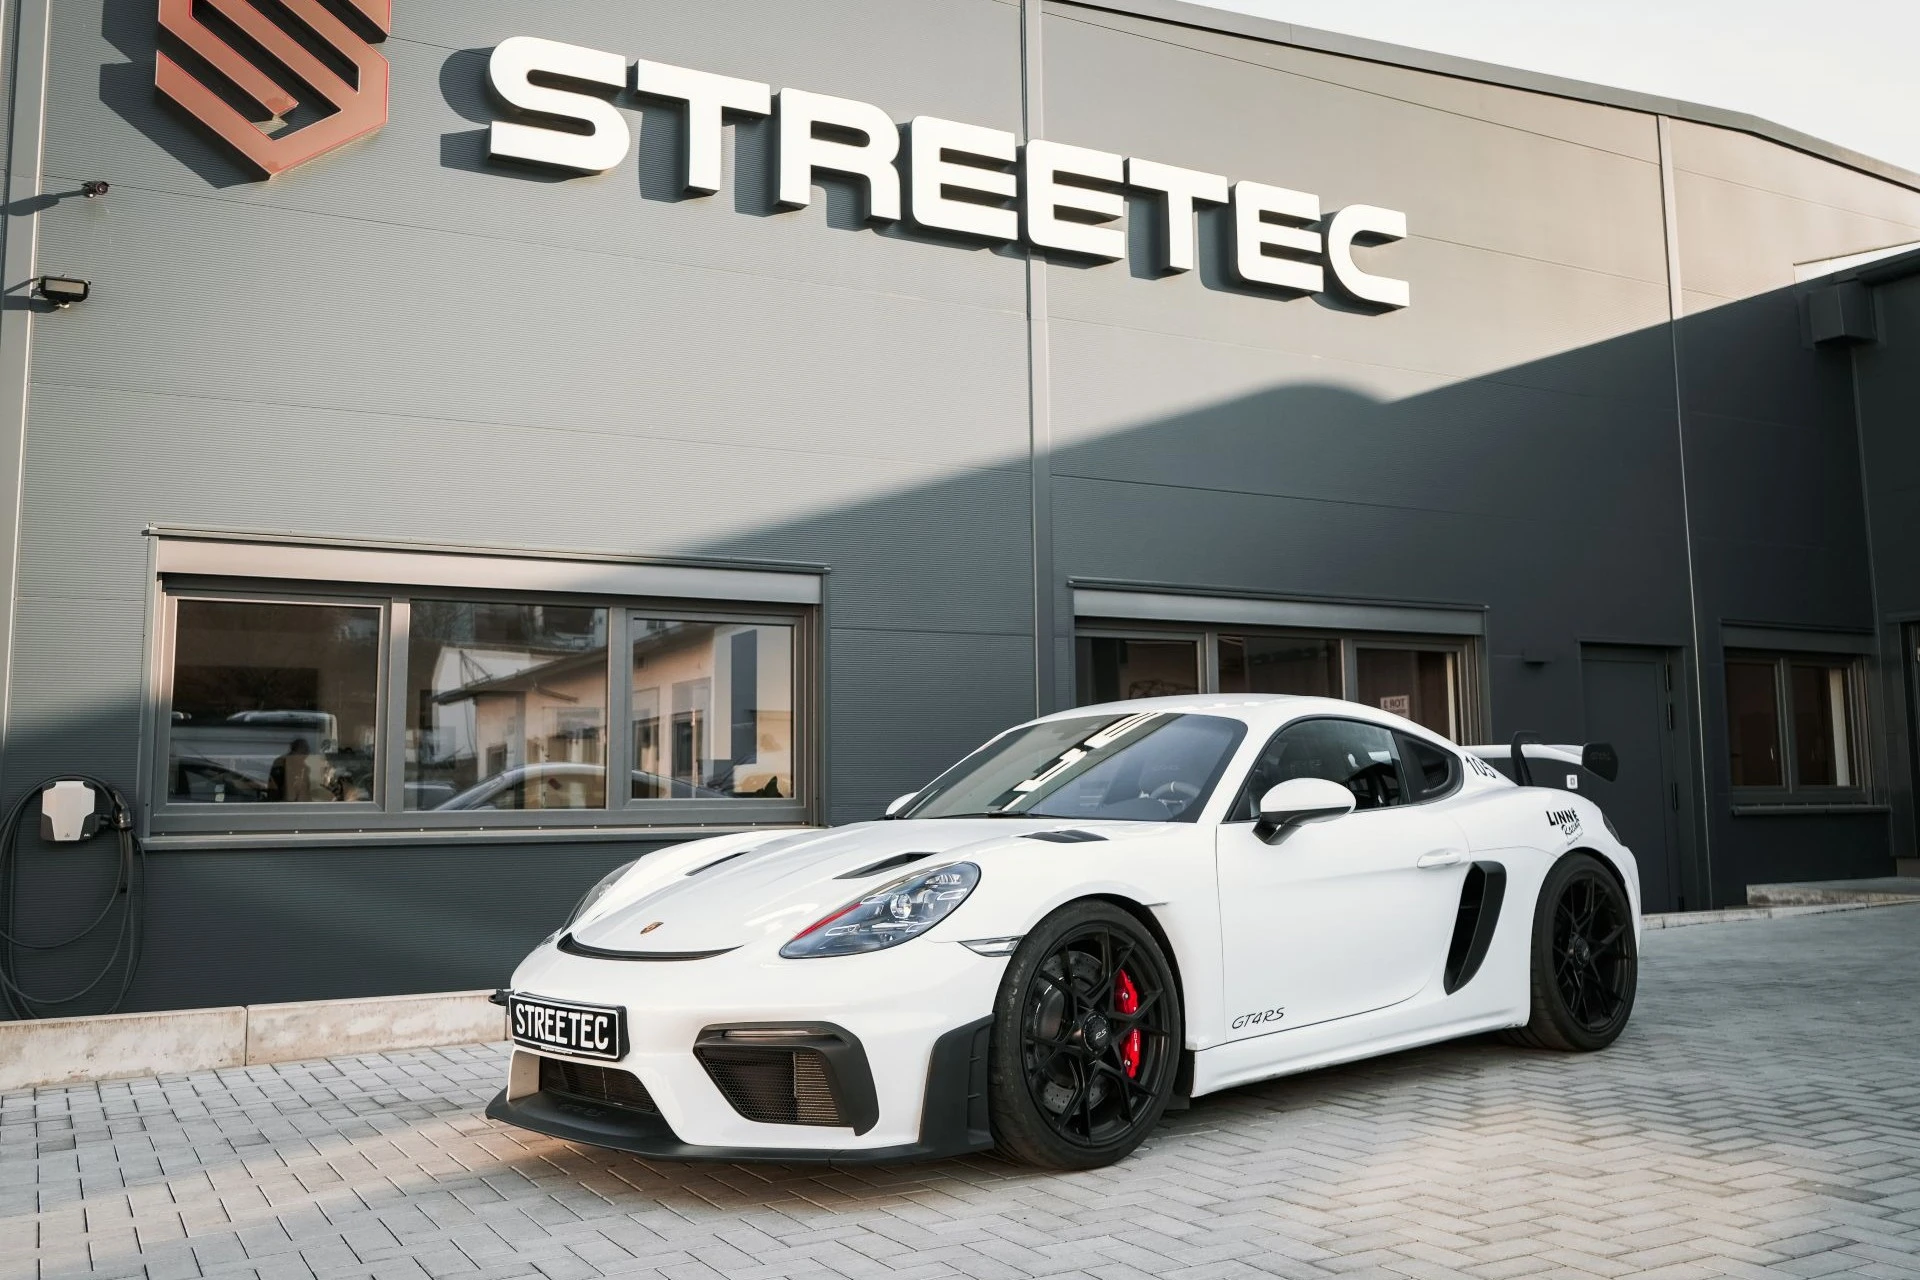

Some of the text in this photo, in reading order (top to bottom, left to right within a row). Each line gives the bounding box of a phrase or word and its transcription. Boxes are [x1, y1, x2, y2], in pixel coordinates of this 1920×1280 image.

[487, 36, 1411, 310] STREETEC
[1465, 755, 1497, 779] 105
[515, 1003, 609, 1050] STREETEC
